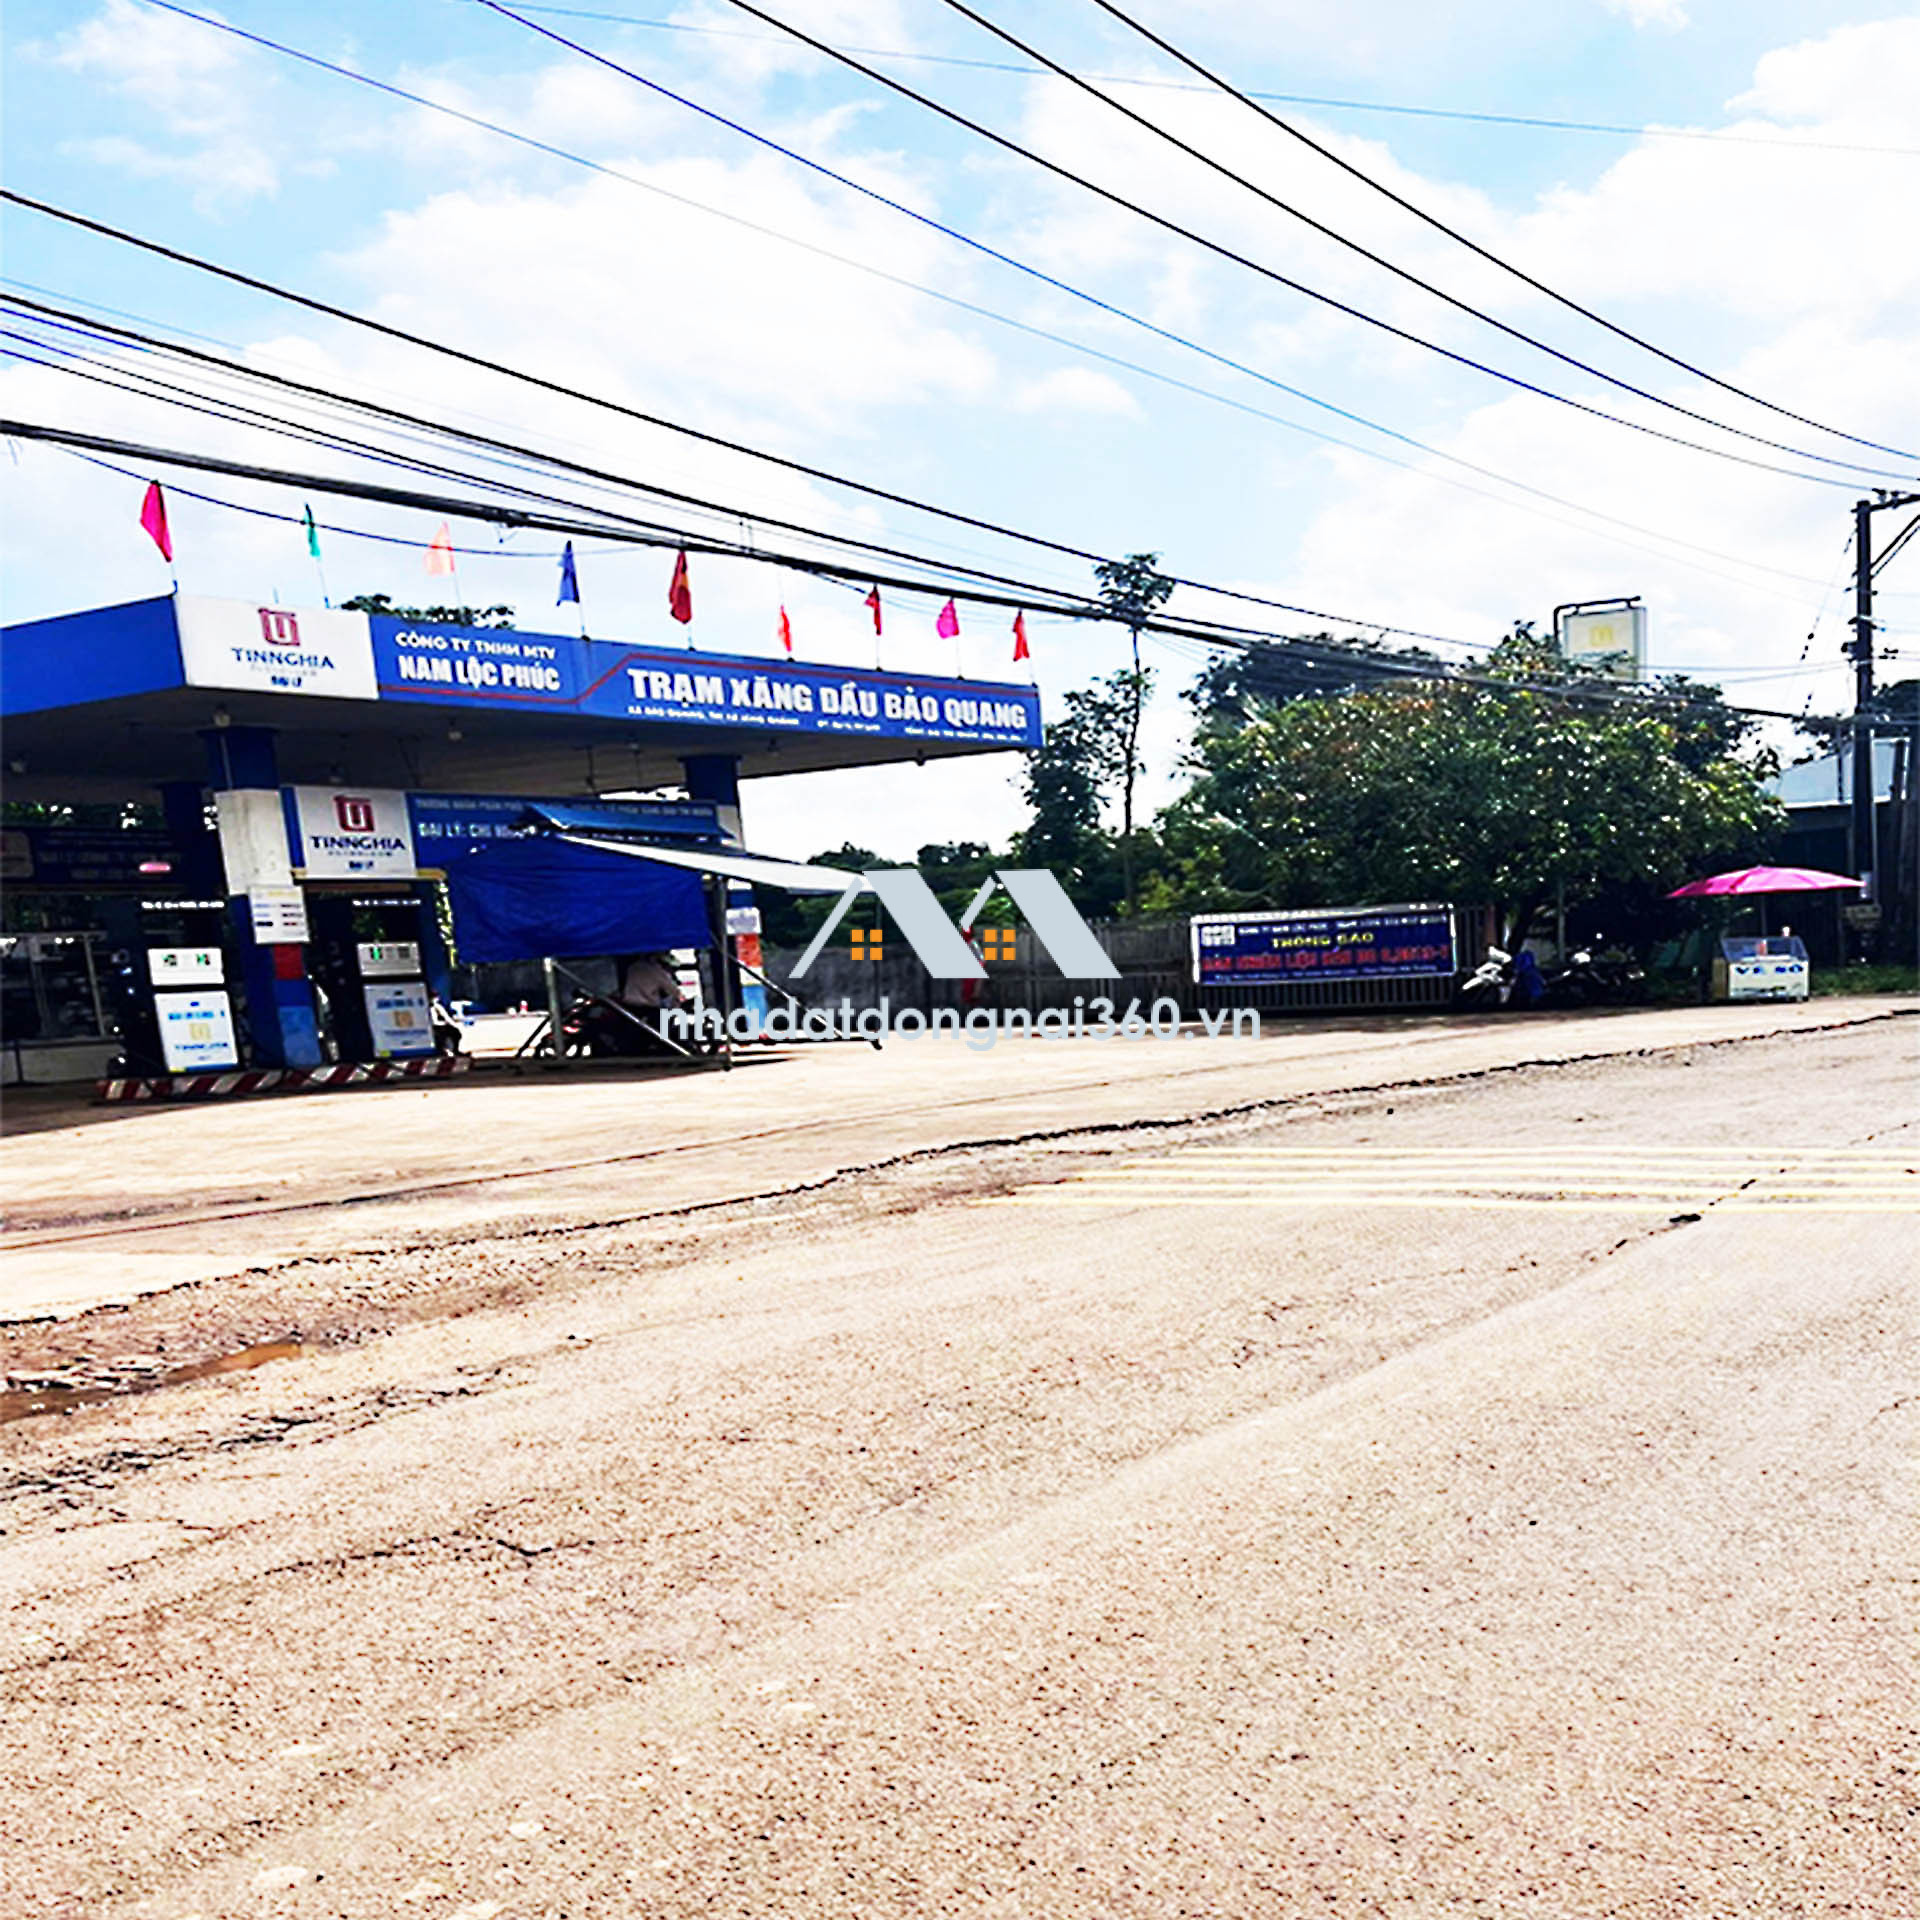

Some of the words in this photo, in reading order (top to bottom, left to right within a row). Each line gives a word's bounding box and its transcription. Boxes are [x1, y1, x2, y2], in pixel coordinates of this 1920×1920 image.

[394, 631, 449, 651] CÔNG
[450, 637, 472, 652] TY
[522, 645, 556, 660] MTV
[398, 655, 453, 683] NAM
[455, 655, 498, 689] LỘC
[501, 661, 561, 692] PHÚC
[627, 668, 725, 708] TRẠM
[730, 675, 814, 714] XĂNG
[884, 685, 939, 722] BẢO
[944, 698, 1028, 729] QUANG
